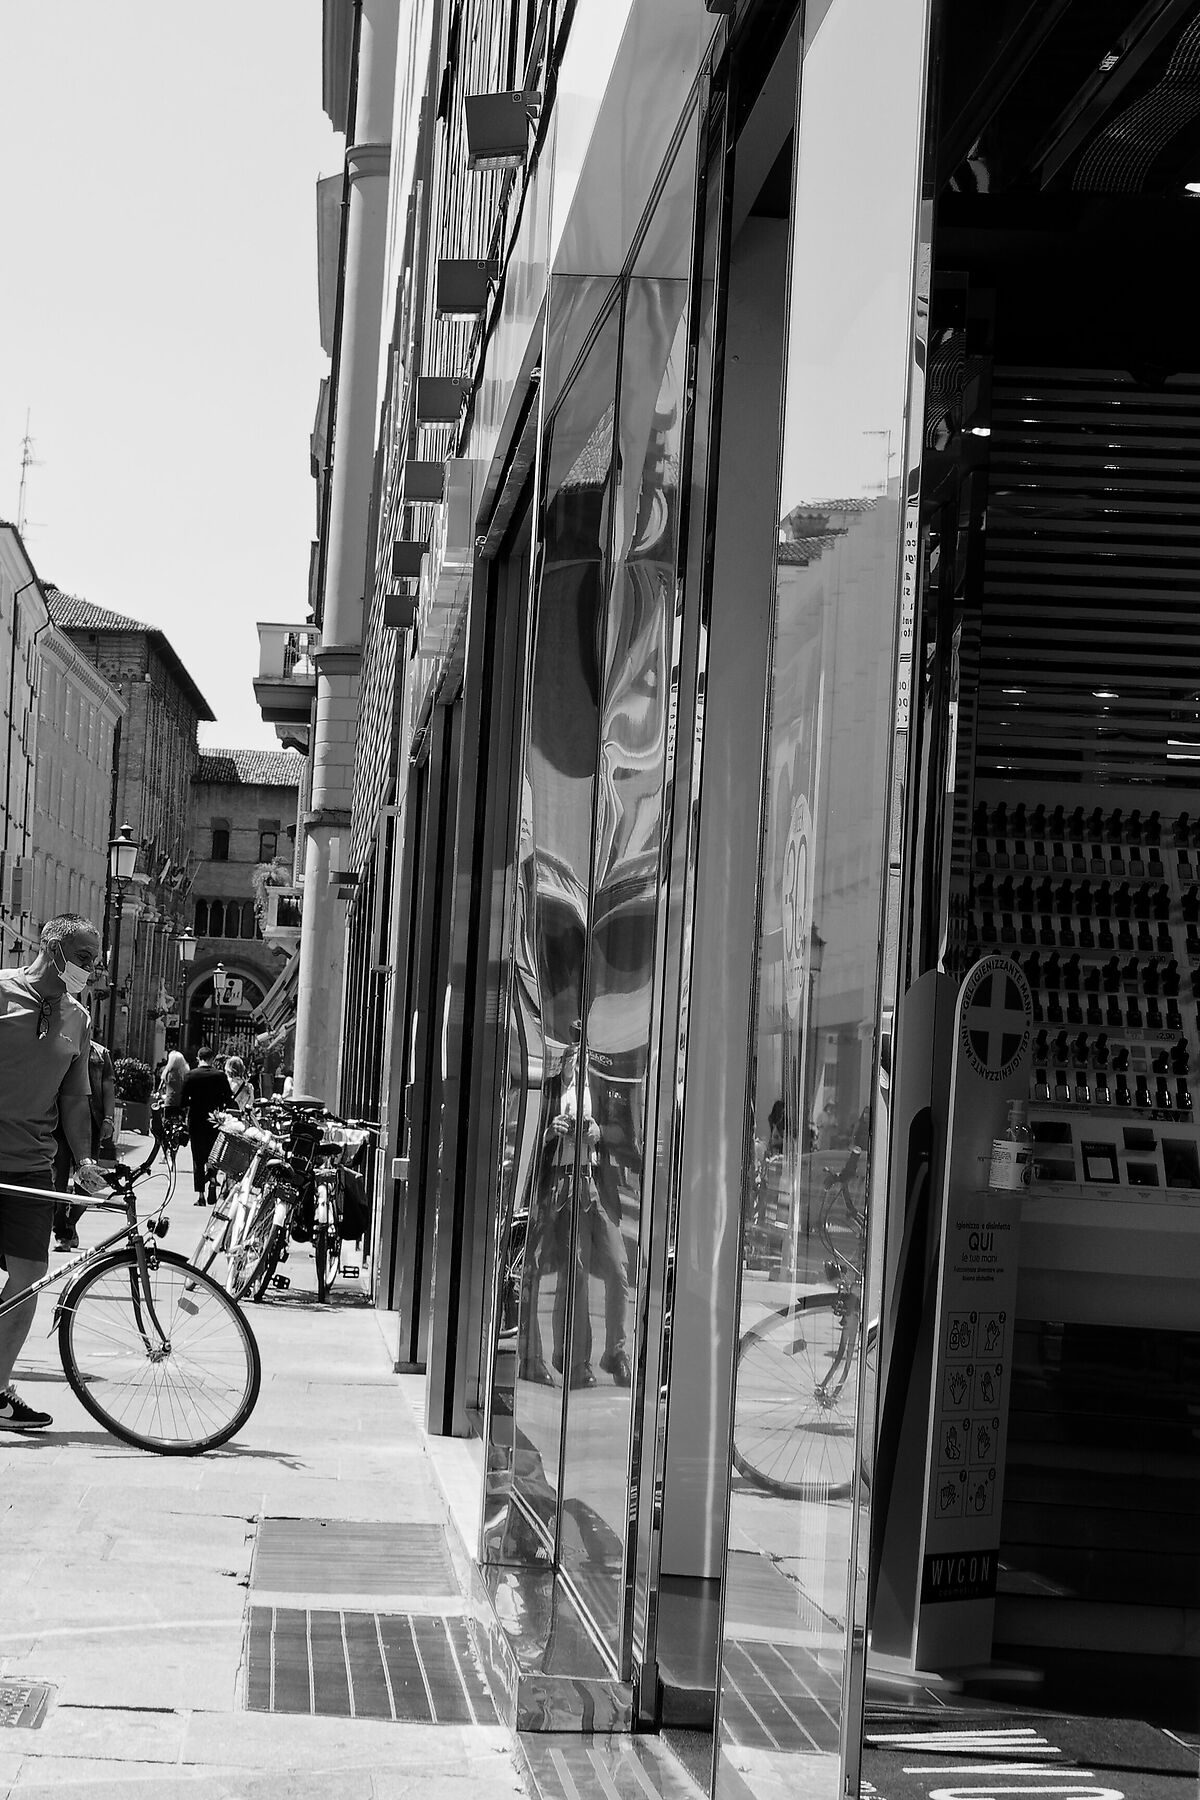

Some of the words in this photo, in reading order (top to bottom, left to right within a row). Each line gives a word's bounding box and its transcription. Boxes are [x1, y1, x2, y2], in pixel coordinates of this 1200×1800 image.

[962, 985, 975, 1010] GEL
[1019, 983, 1032, 1016] MANI
[969, 1232, 993, 1251] QUI
[932, 1555, 989, 1586] WYCON
